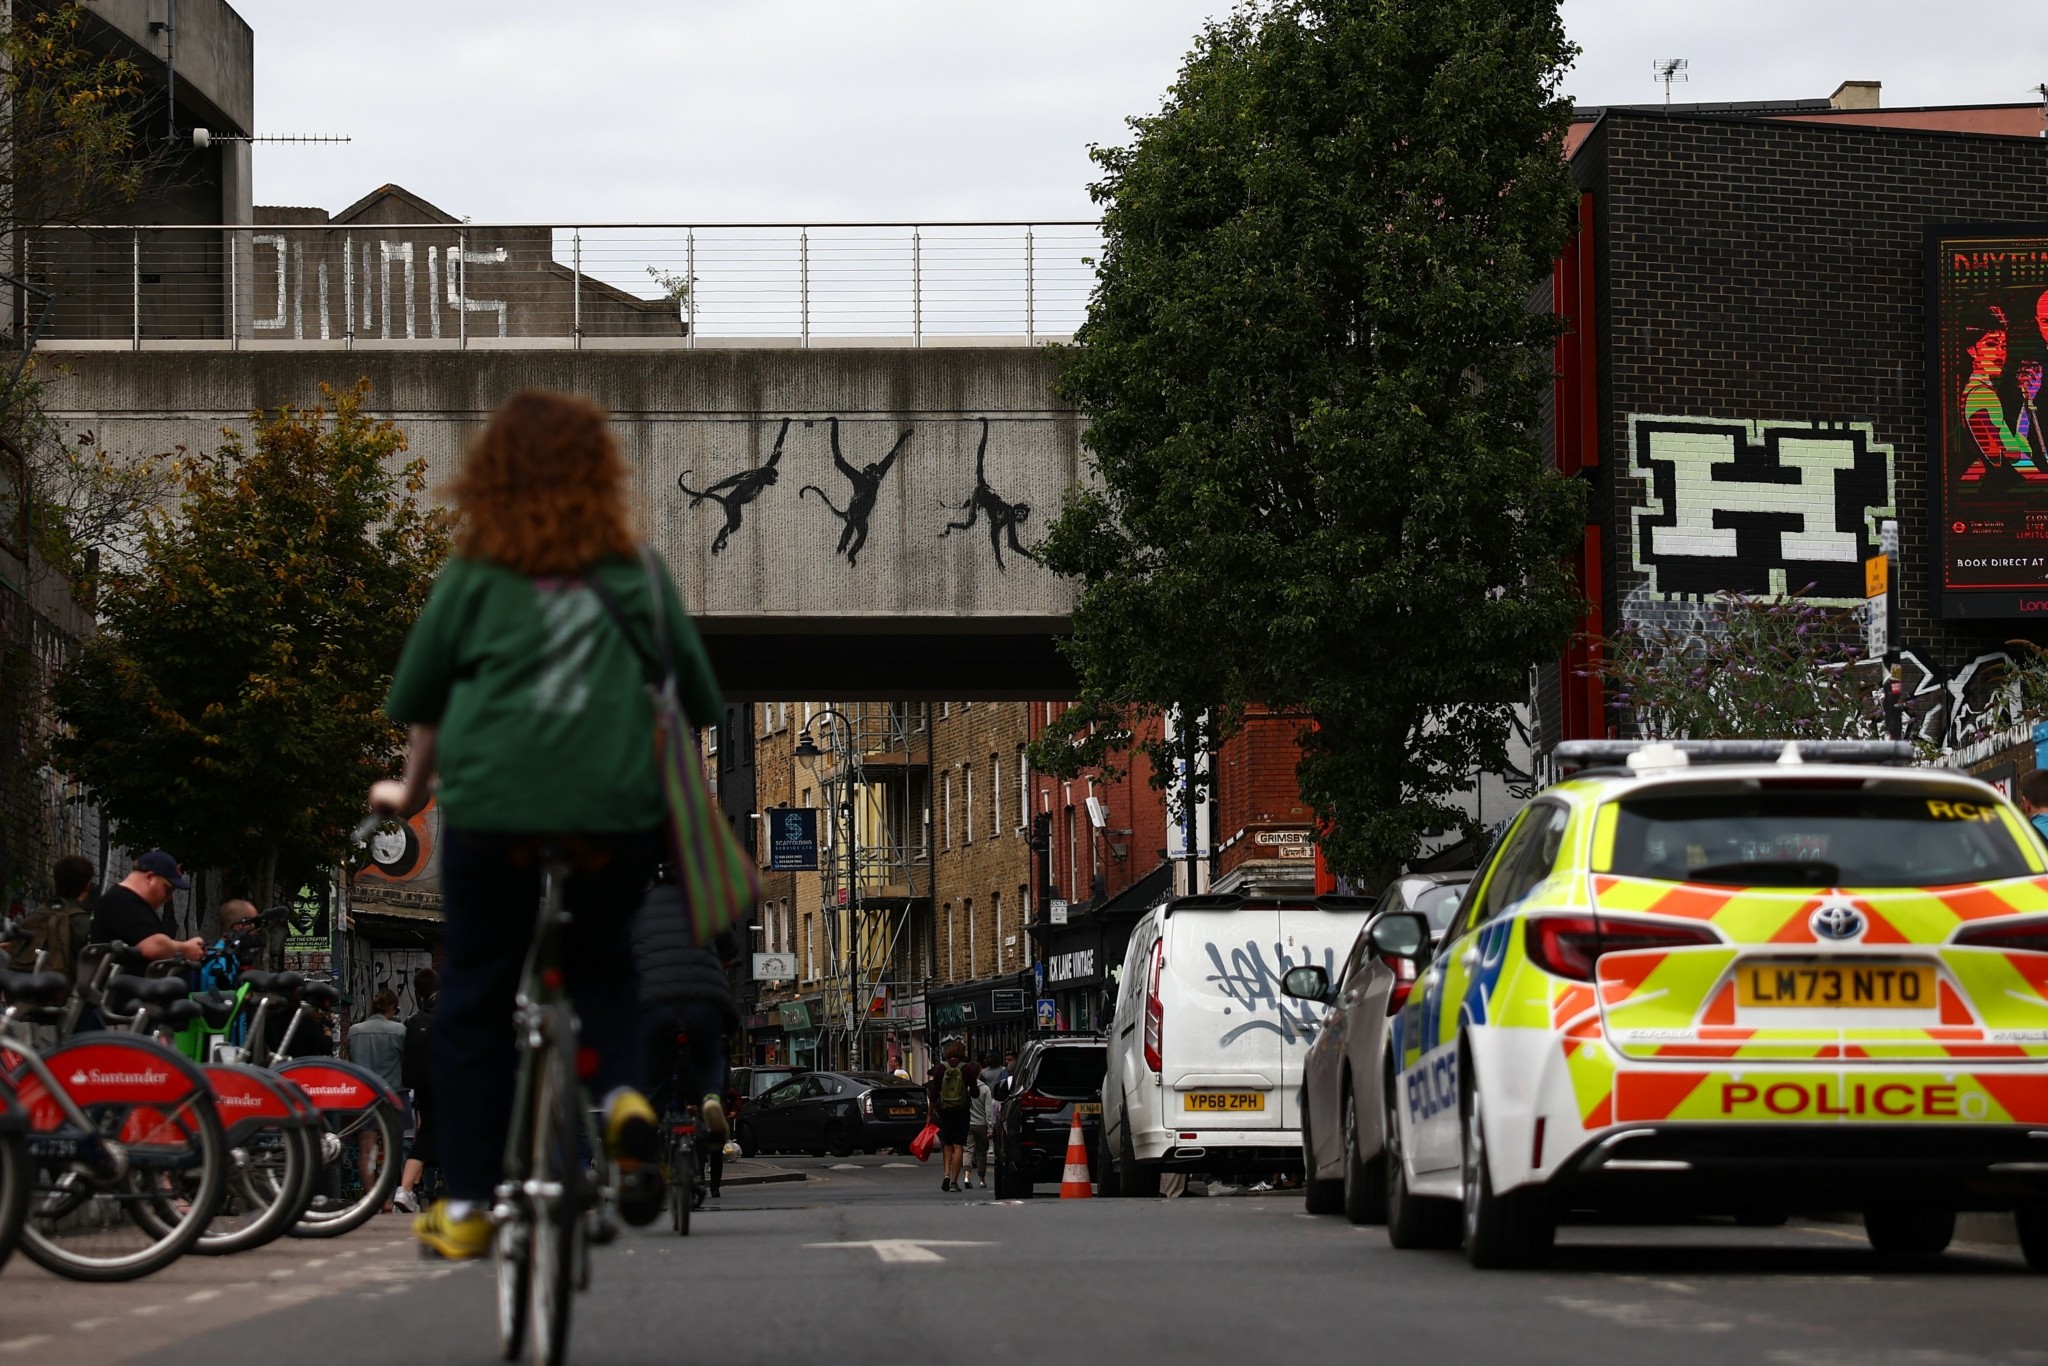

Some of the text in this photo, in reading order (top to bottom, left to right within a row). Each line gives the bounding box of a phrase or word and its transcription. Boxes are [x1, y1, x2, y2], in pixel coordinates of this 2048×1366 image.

[1957, 558, 2044, 567] BOOK DIRECT AT
[1260, 833, 1306, 843] GRIMSBY
[1058, 953, 1072, 981] LANE
[1072, 948, 1094, 979] VINTAGE
[1752, 969, 1920, 1003] LM73 NTO
[88, 1068, 169, 1085] Santander
[301, 1083, 357, 1096] Santander
[1190, 1094, 1257, 1108] YP68 ZPH
[1721, 1082, 1958, 1115] POLICE
